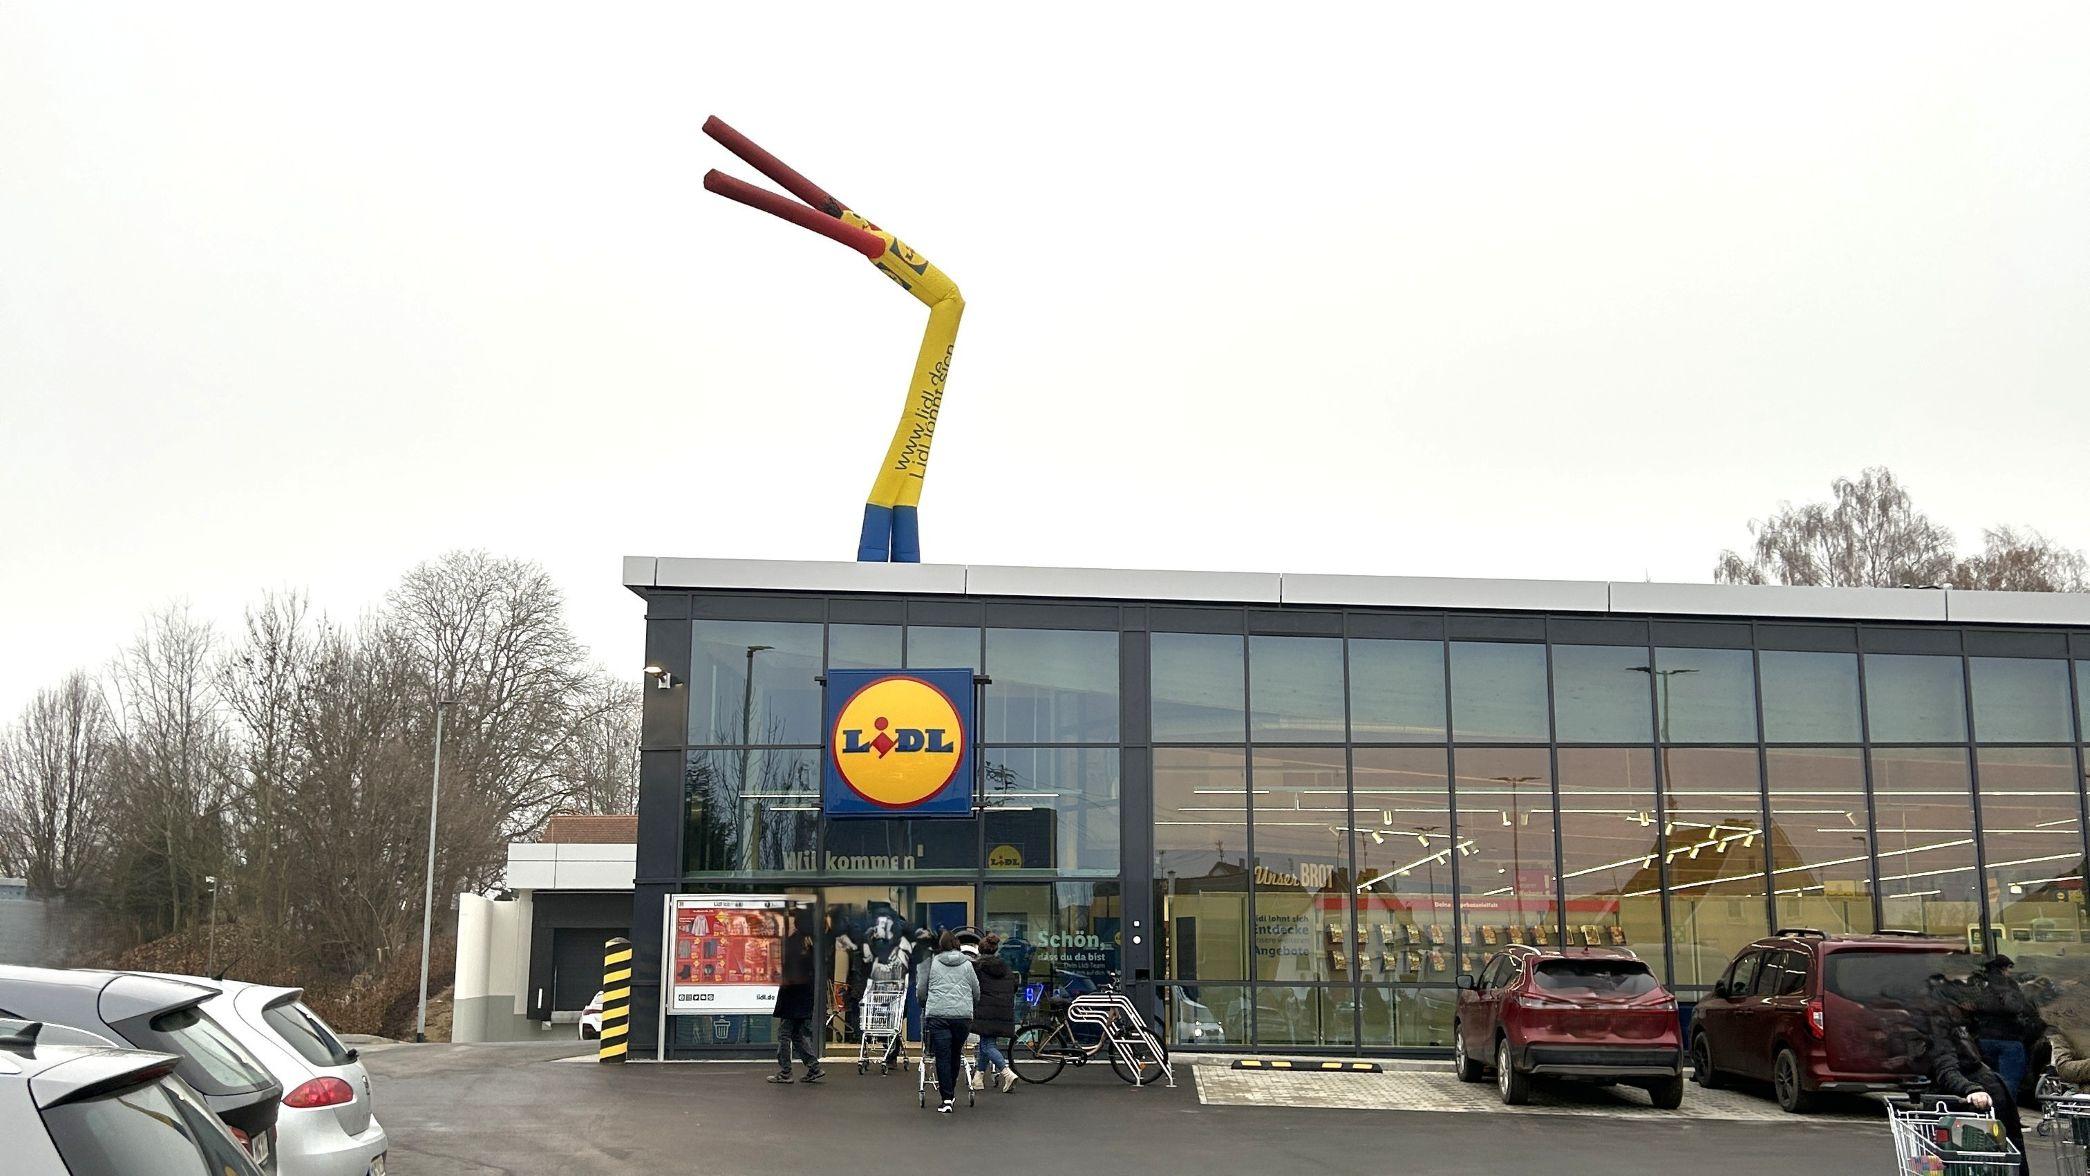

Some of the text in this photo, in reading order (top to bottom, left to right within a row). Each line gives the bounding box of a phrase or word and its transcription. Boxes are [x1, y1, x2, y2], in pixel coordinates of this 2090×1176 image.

[842, 716, 954, 760] LIDL
[782, 850, 916, 871] Wilkommen
[990, 855, 1020, 866] LIDL
[1255, 862, 1334, 888] Unser BROT
[1268, 914, 1290, 922] lohnt
[1291, 914, 1309, 922] sich
[1038, 930, 1105, 950] Schön,
[1037, 952, 1106, 961] dass du da bist
